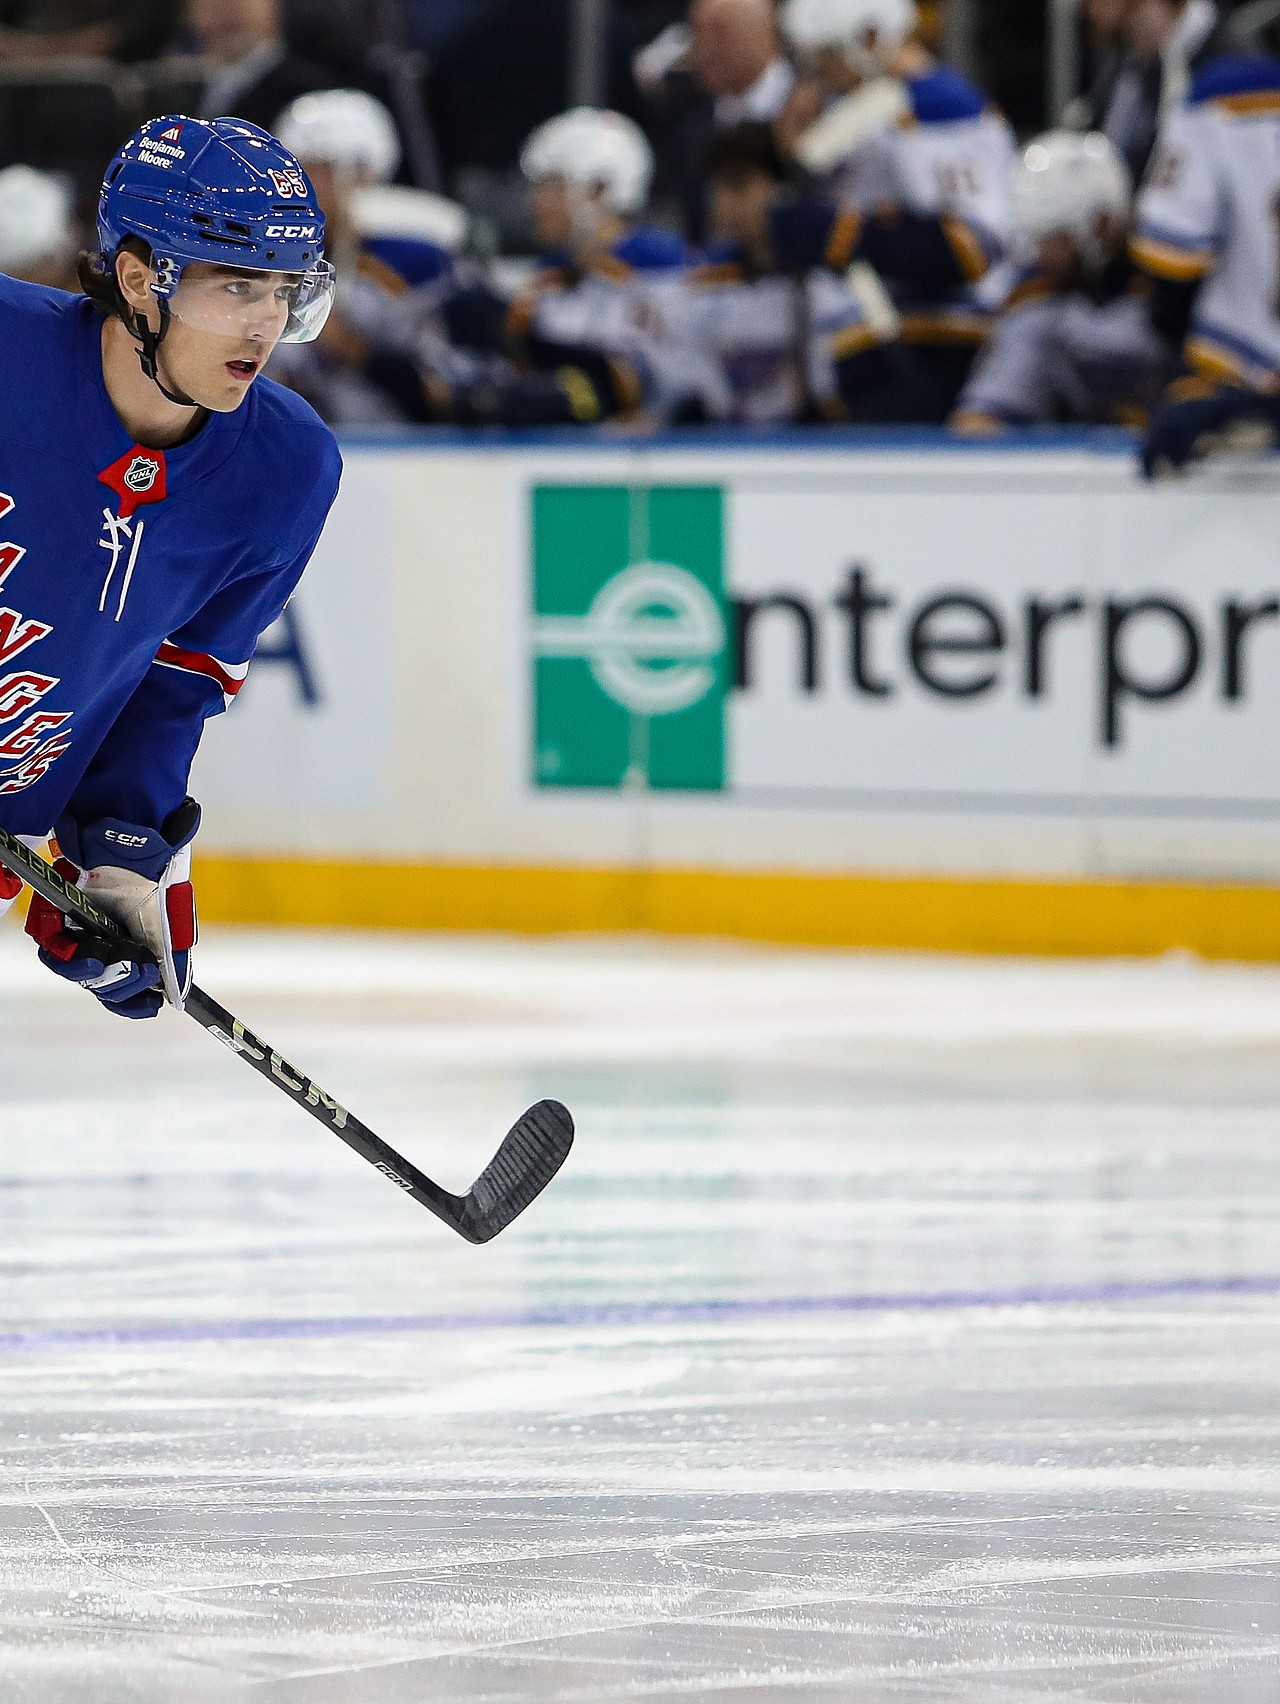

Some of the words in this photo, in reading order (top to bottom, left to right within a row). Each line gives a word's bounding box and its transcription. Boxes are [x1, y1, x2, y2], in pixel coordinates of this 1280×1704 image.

[138, 136, 186, 159] Benjamin
[137, 149, 171, 169] Moore
[269, 169, 308, 199] 65
[265, 225, 316, 238] CCM
[130, 468, 152, 481] NHL
[104, 829, 149, 845] CCM
[374, 1164, 411, 1188] CCM
